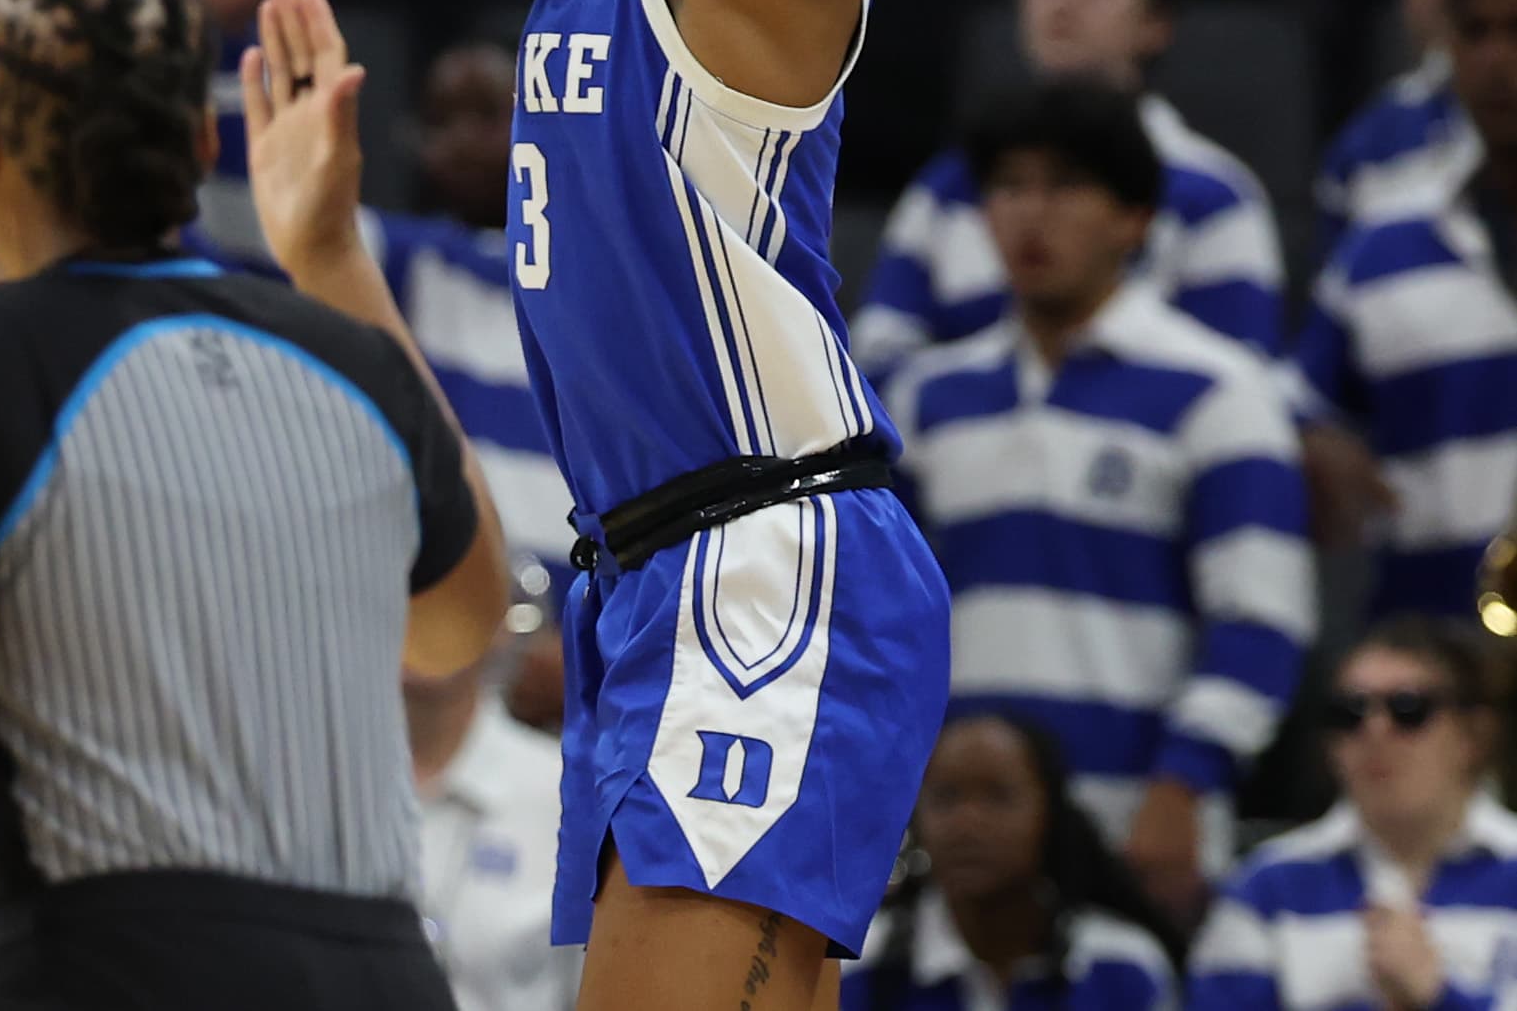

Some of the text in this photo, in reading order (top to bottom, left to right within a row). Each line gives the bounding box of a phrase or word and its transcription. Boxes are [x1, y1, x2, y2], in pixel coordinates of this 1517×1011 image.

[515, 32, 612, 113] KE
[512, 142, 551, 290] 3
[686, 730, 773, 808] D
